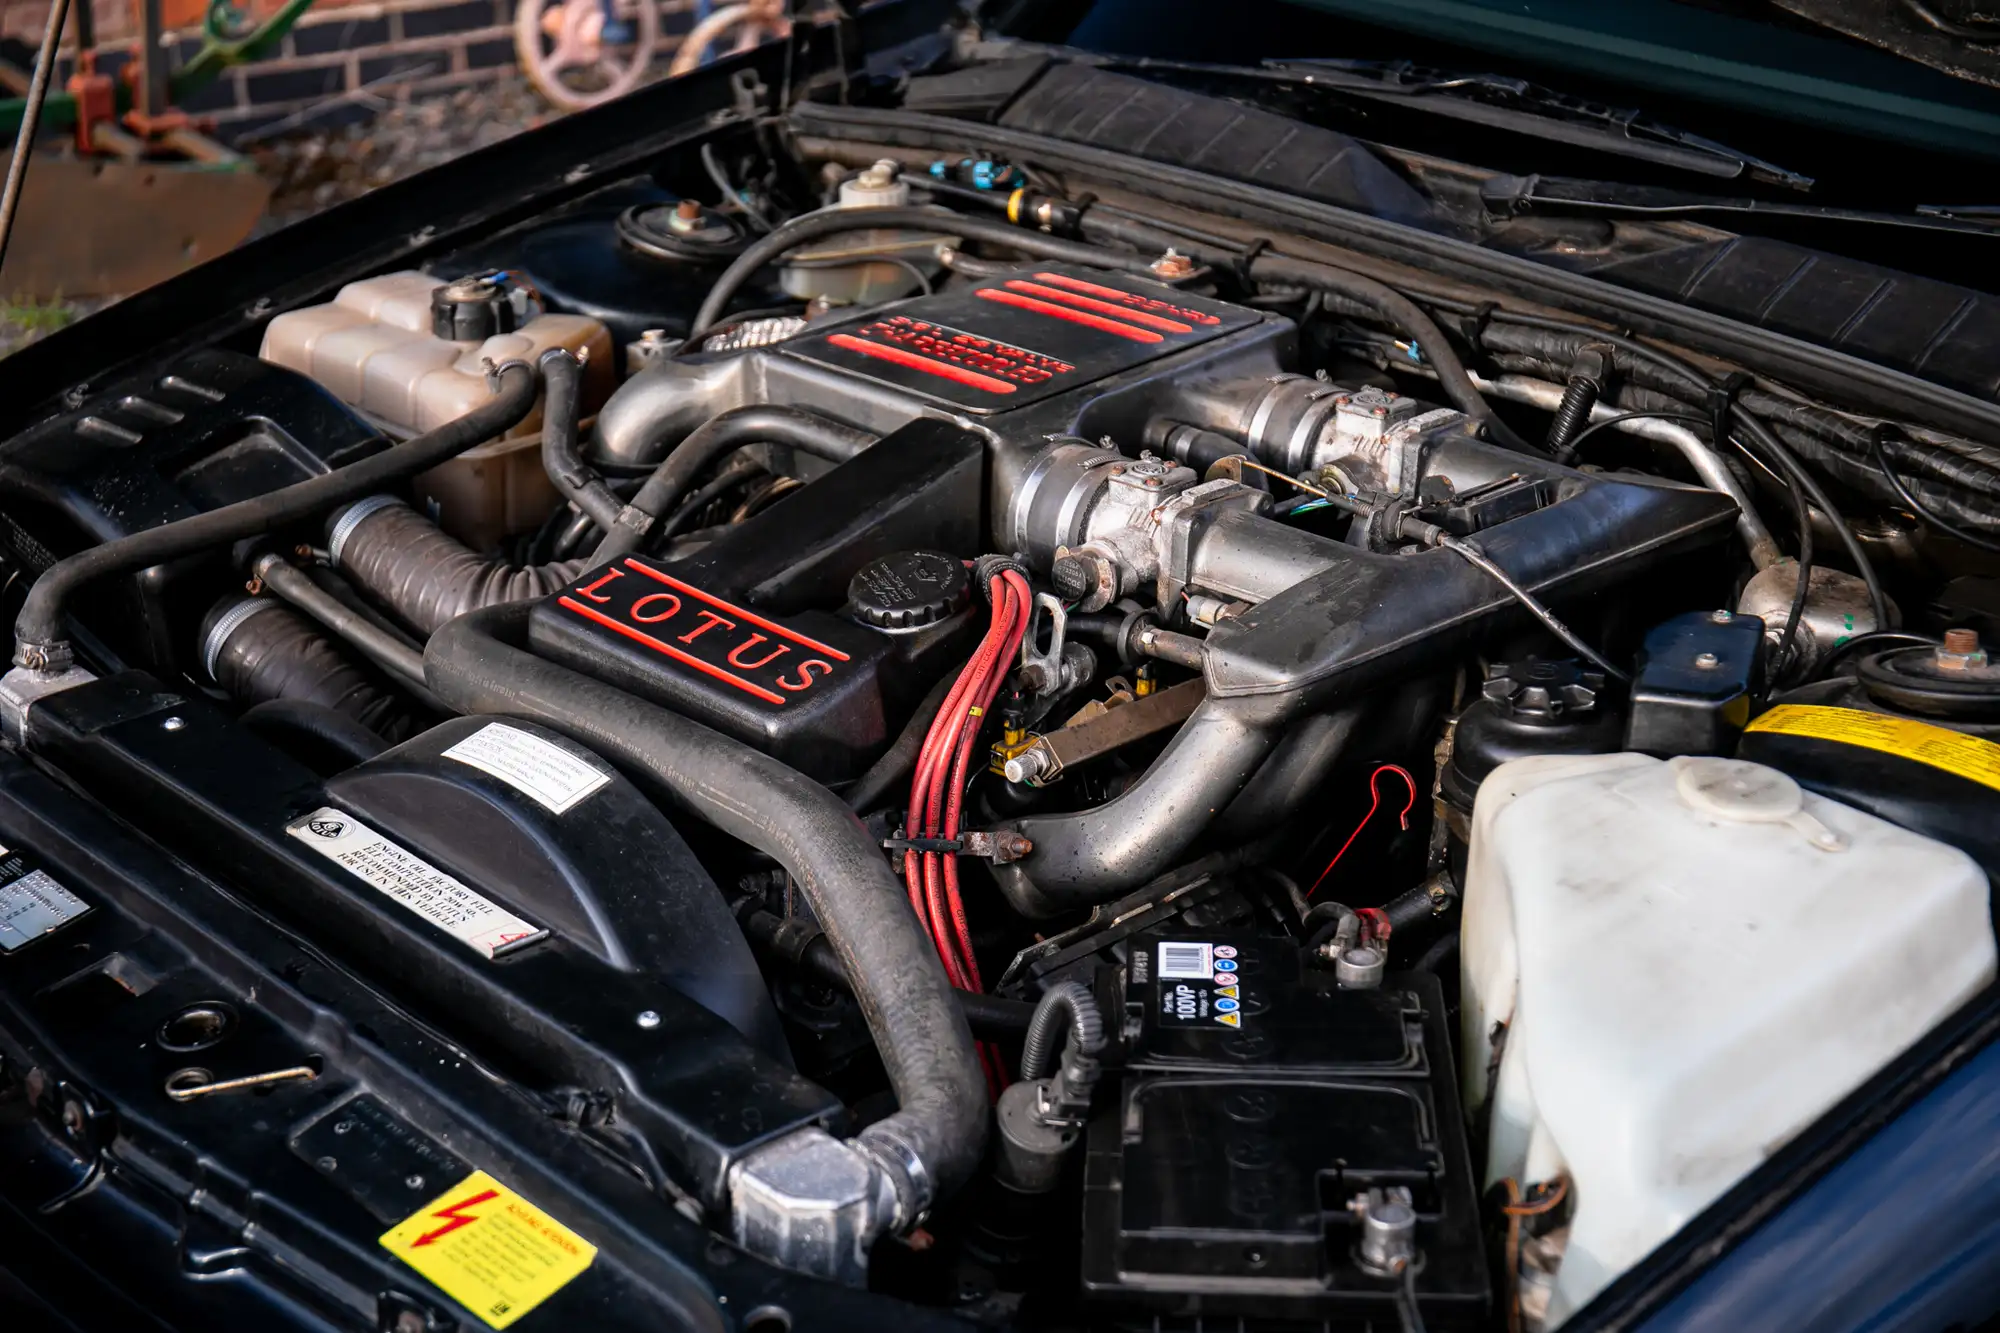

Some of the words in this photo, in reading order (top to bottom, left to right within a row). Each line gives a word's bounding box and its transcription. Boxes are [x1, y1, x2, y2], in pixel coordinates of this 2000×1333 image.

[859, 322, 1052, 383] CHARGECOOLED
[995, 344, 1076, 374] VALVE
[575, 567, 833, 691] LOTUS
[310, 822, 338, 838] LOTUS
[337, 852, 357, 867] FOR
[356, 864, 376, 878] USE
[375, 876, 388, 886] IN
[390, 884, 414, 901] THIS
[350, 849, 422, 894] RECOMMENDED
[420, 891, 435, 902] BY
[435, 900, 467, 922] LOTUS
[362, 845, 385, 861] ELF
[382, 856, 443, 897] COMPETITION
[372, 841, 409, 865] ENGINE
[429, 875, 469, 901] FACTORY
[469, 900, 494, 916] FILL
[1176, 985, 1196, 1020] 100VP
